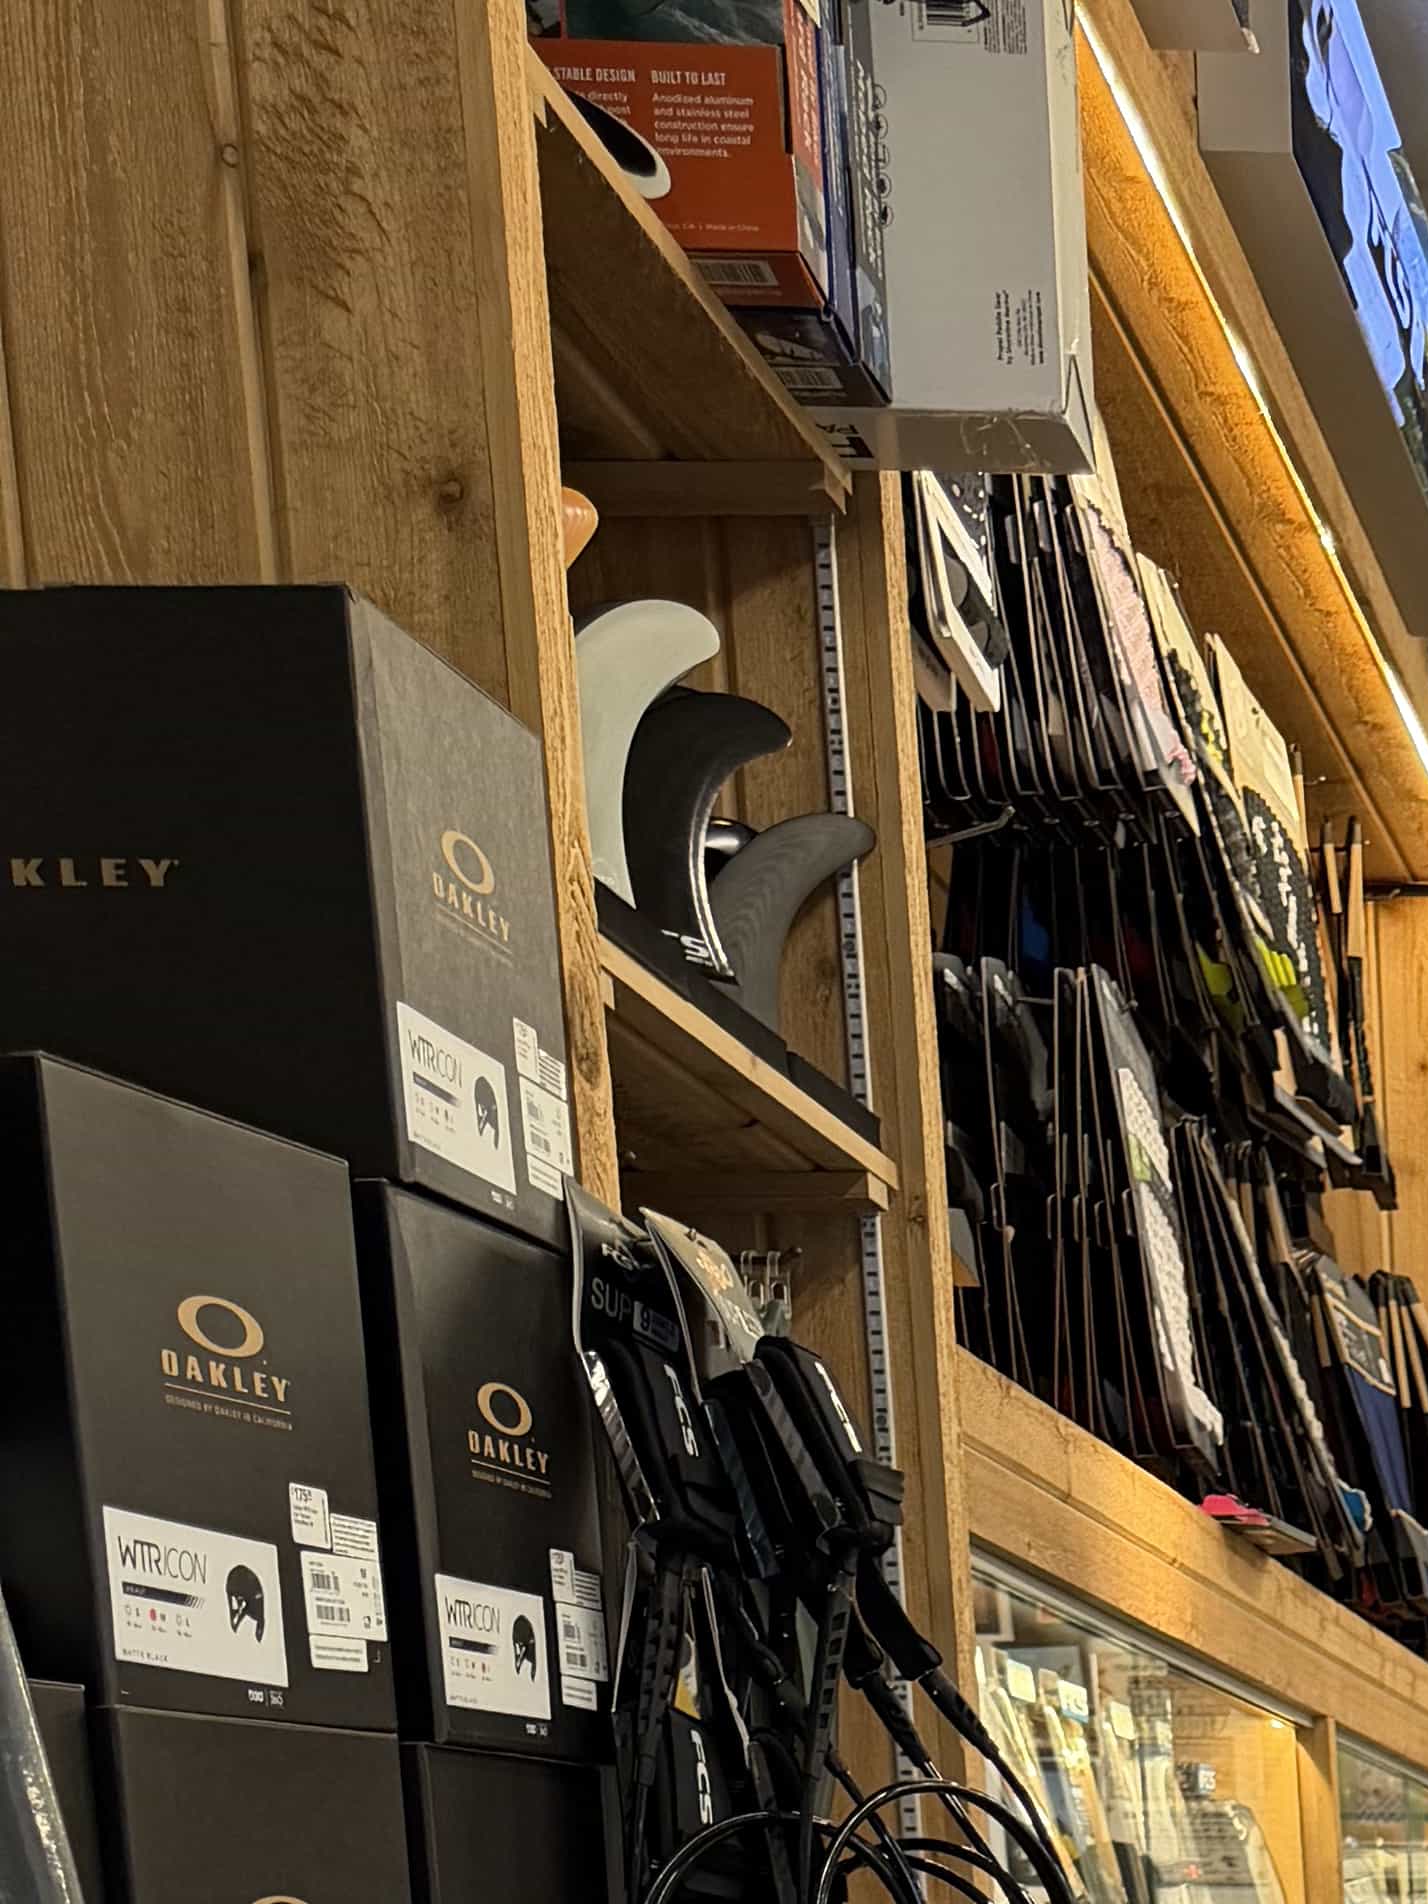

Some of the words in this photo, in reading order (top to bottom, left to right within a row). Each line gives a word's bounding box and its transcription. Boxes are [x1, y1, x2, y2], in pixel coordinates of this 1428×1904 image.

[596, 68, 636, 82] DESIGN
[651, 70, 681, 84] BUILT
[685, 72, 698, 85] TO
[701, 73, 726, 86] LAST
[652, 93, 701, 105] Anodized
[704, 95, 753, 106] aluminum
[654, 107, 673, 117] and
[676, 107, 721, 118] stainless
[724, 109, 749, 119] steel
[654, 119, 718, 132] construction
[655, 132, 679, 145] long
[714, 135, 751, 145] coastal
[432, 871, 511, 942] OAKLEY
[592, 1277, 632, 1322] SUP
[161, 1348, 291, 1403] OAKLEY
[664, 1363, 699, 1458] FCS
[467, 1429, 549, 1475] OAKLEY
[689, 1728, 714, 1826] FCS
